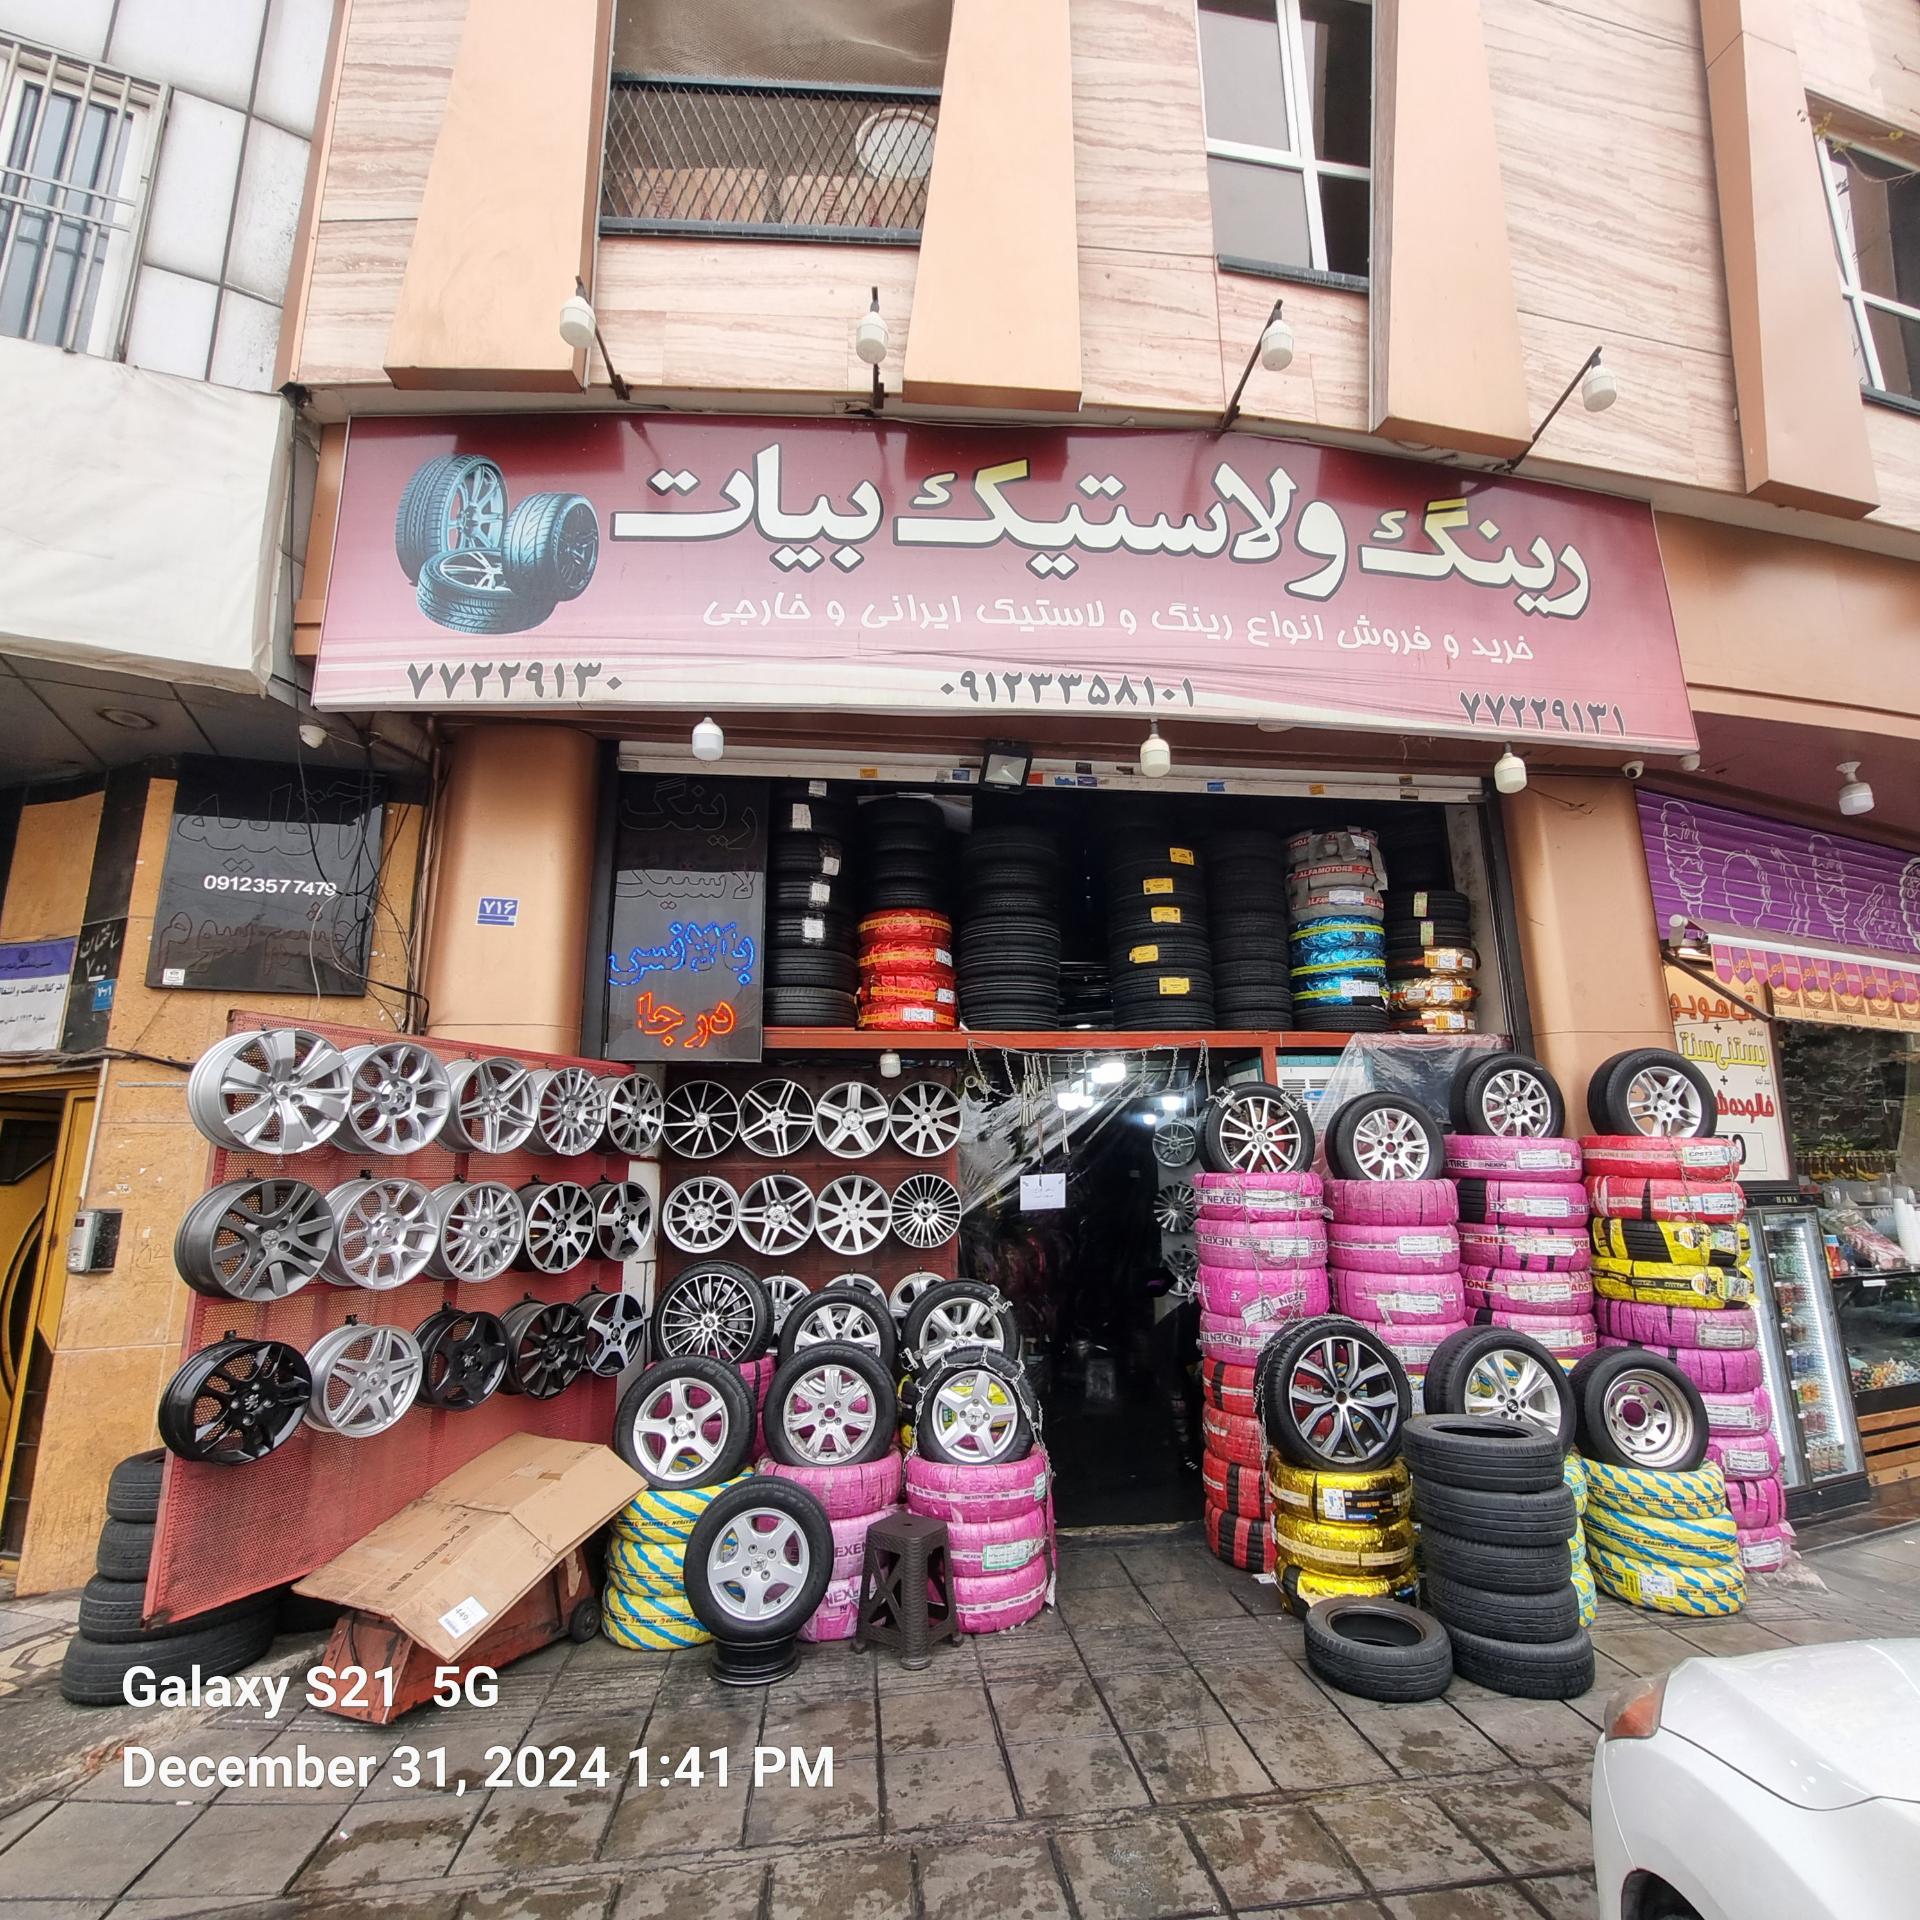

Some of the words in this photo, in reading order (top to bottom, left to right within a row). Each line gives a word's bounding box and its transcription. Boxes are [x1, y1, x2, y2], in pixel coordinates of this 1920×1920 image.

[610, 443, 882, 573] بیات
[1358, 497, 1591, 620] رینگ
[703, 592, 811, 626] خارجی
[827, 600, 846, 626] و
[861, 594, 962, 630] ایرانی
[976, 598, 1105, 632] لاستیک
[1119, 608, 1137, 635] و
[1151, 602, 1233, 640] رینگ
[1247, 610, 1324, 648] انواع
[1337, 614, 1432, 655] فروش
[1443, 633, 1460, 660] و
[1471, 635, 1534, 664] خرید
[407, 661, 623, 699] ۷۷۲۲۹۱۳۰
[940, 670, 1194, 707] ۰۹۱۲۳۳۵۸۱۰۱
[1459, 691, 1624, 736] ۷۷۲۲۹۱۳۱
[204, 874, 337, 897] 09123577479
[483, 900, 516, 915] ۷۱۶
[1207, 1194, 1241, 1205] NEXEN
